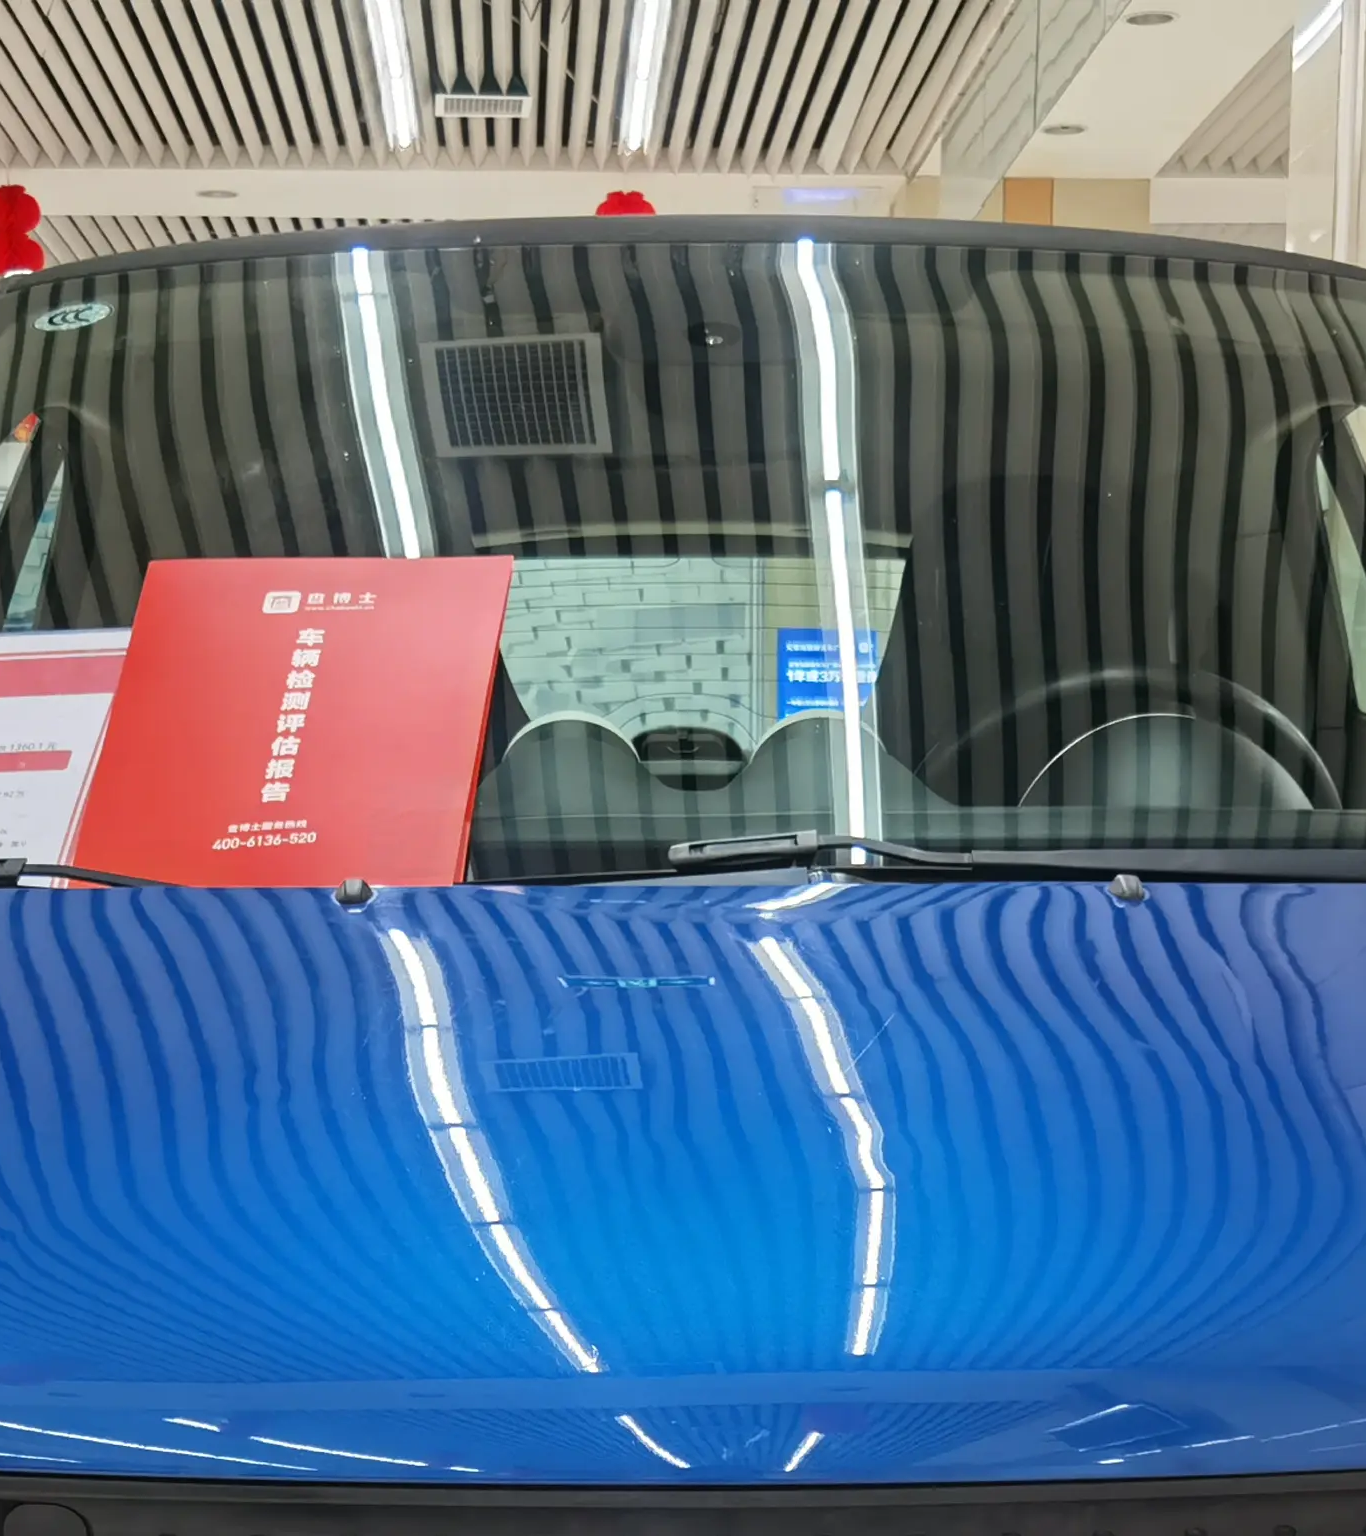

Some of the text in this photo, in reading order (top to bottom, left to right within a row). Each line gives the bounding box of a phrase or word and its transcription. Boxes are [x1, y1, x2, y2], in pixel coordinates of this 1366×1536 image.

[260, 628, 325, 803] 车辆检测评估报告
[212, 832, 317, 851] 400-6136-520
